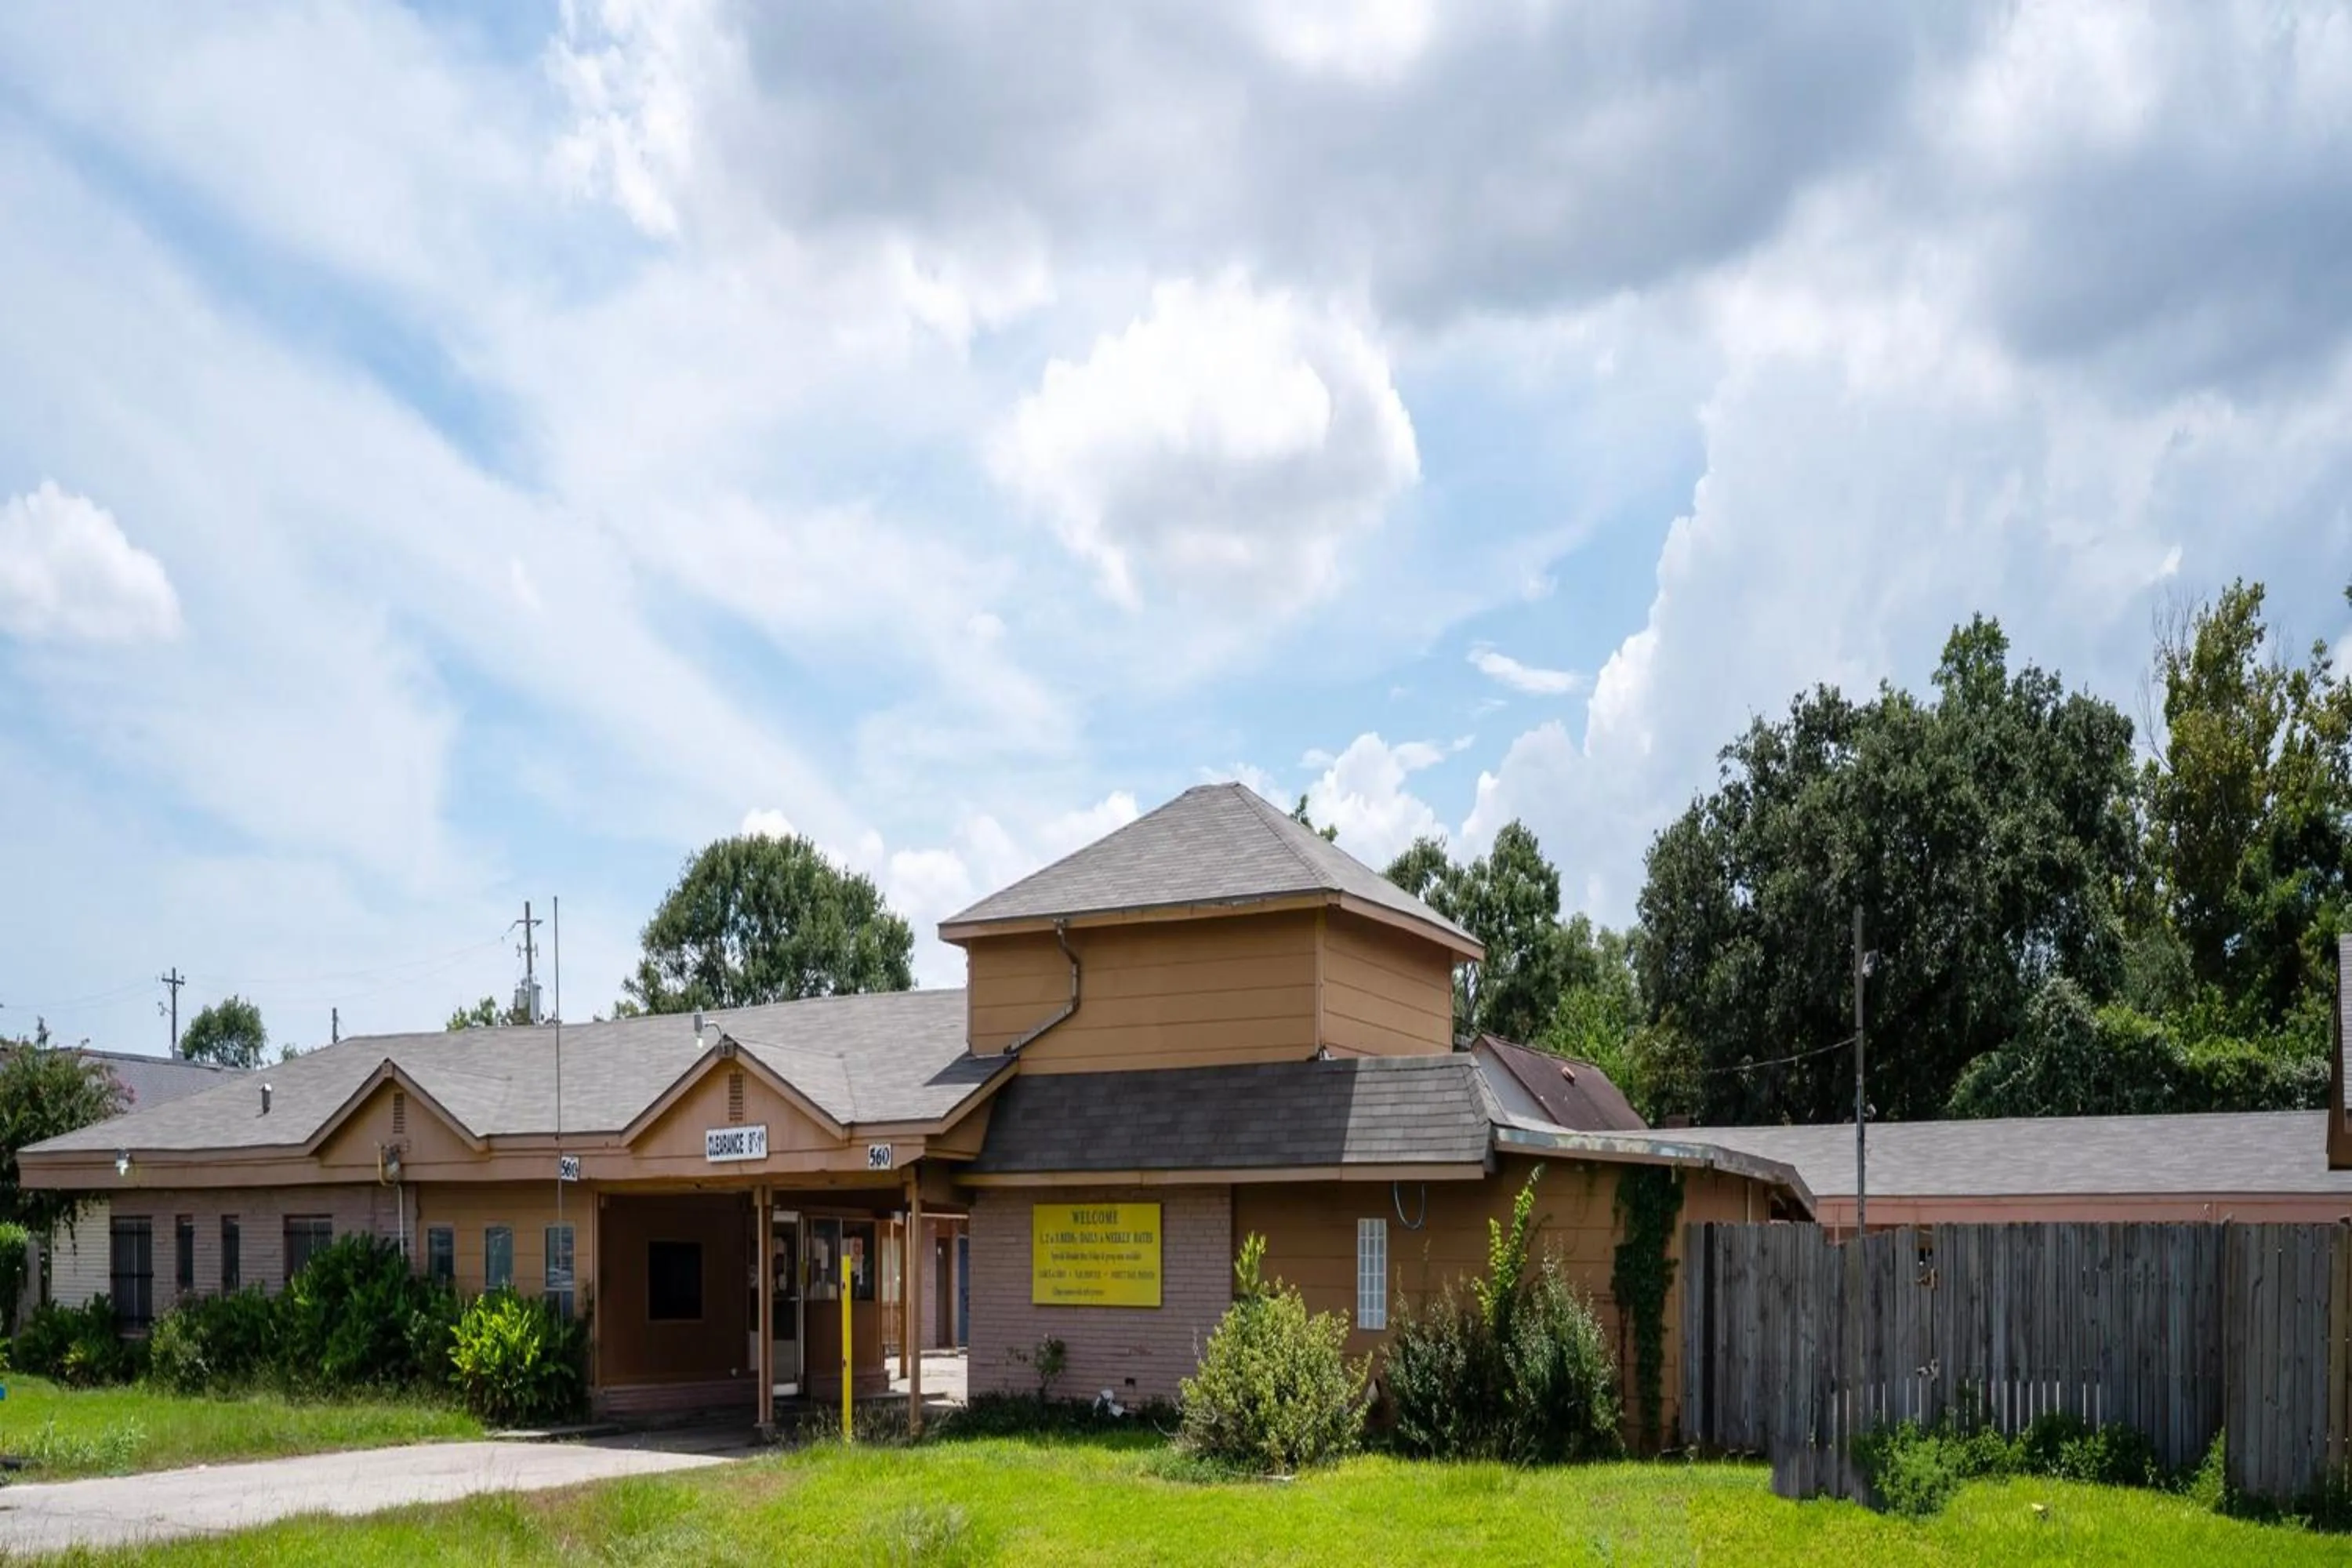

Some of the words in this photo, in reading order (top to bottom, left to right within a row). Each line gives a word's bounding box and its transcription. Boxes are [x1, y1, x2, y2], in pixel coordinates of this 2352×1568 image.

[708, 1134, 744, 1156] CLEARANCE
[869, 1147, 889, 1167] 560
[1072, 1210, 1120, 1225] WELCOME
[1105, 1232, 1131, 1243] WEEKLY
[1134, 1232, 1153, 1243] RATES
